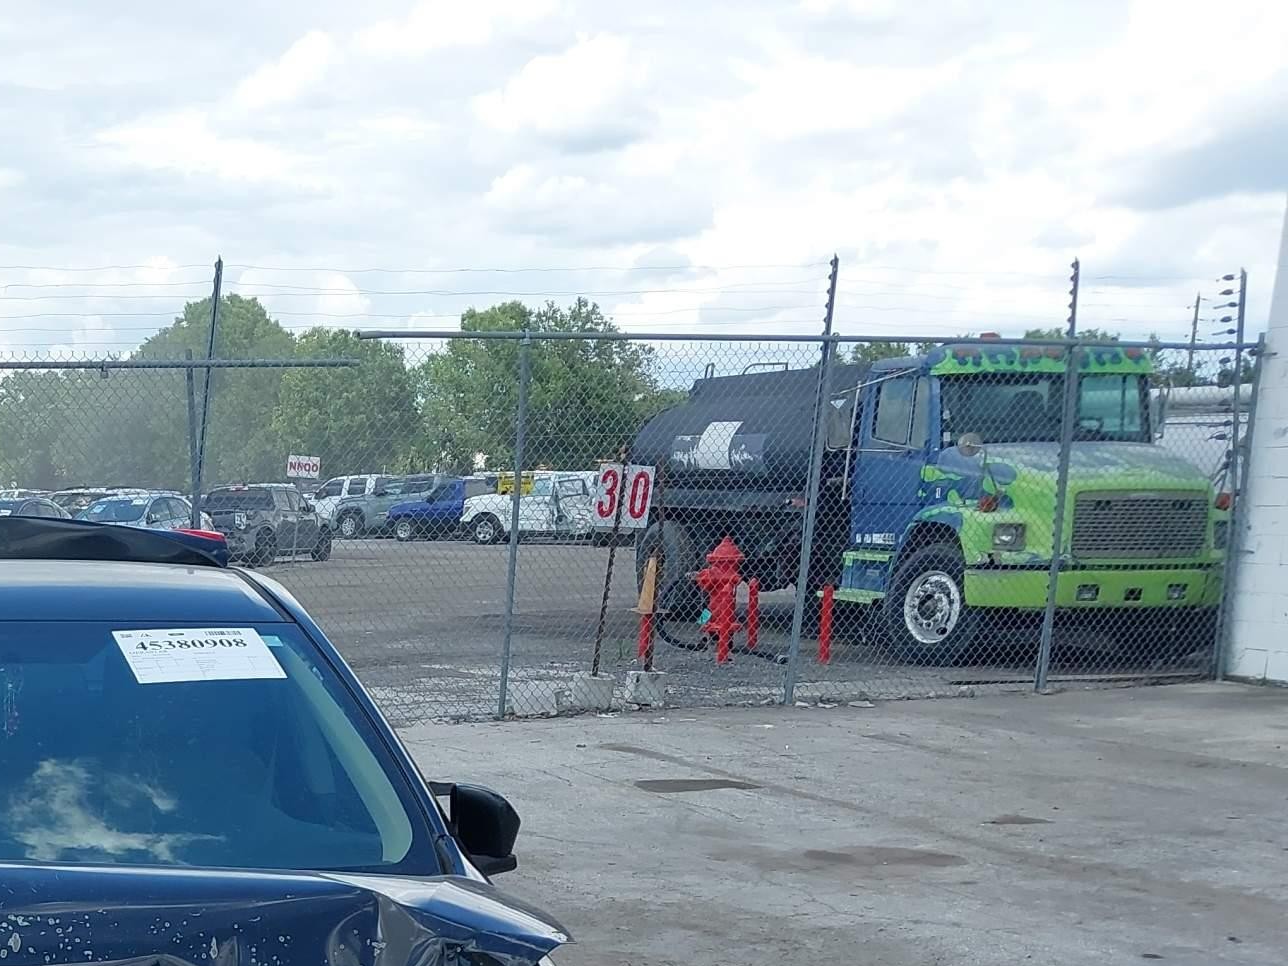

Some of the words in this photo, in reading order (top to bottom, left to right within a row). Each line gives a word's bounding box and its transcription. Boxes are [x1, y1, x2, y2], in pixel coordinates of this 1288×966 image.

[289, 461, 319, 473] NNOO
[597, 469, 650, 519] 30
[135, 638, 248, 651] 45380908
